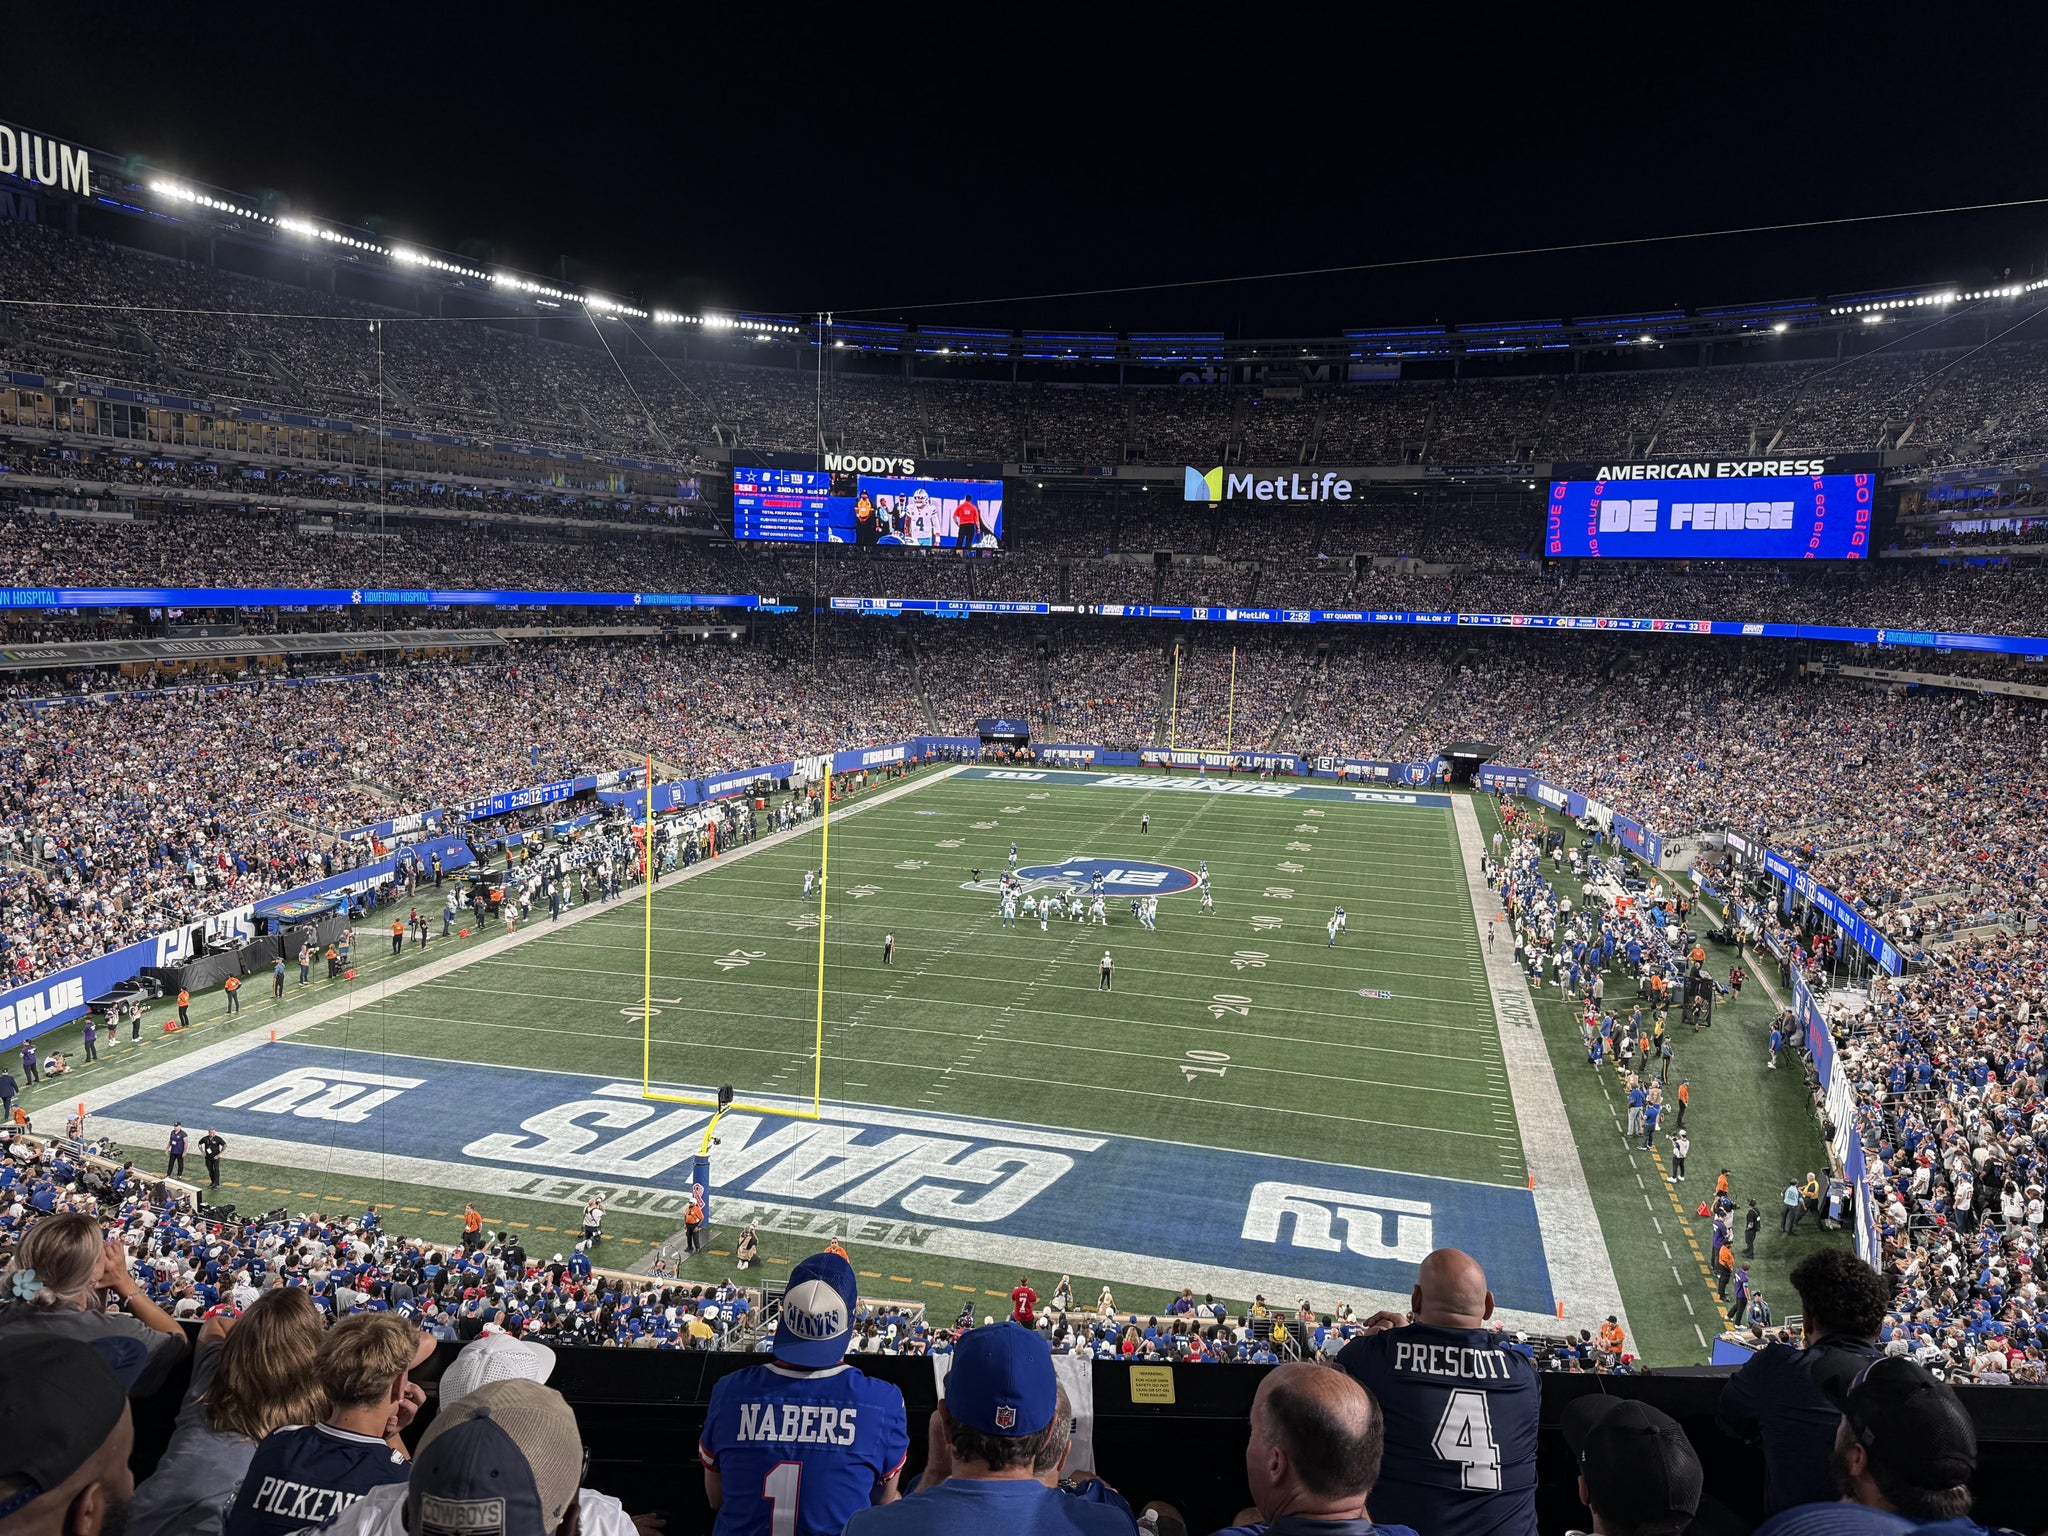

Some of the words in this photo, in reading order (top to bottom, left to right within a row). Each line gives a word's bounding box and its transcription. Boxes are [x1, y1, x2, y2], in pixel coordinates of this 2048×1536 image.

[0, 124, 90, 197] DIUM
[824, 454, 915, 475] MOODY'S
[1596, 462, 1710, 480] AMERICAN
[1716, 459, 1825, 478] EXPRESS
[807, 475, 815, 484] 7
[1227, 472, 1353, 500] MetLife
[1815, 494, 1826, 517] GO
[915, 517, 924, 532] 4
[1587, 499, 1600, 536] BLUE
[1599, 499, 1659, 532] DE
[1670, 501, 1795, 531] FENSE
[1550, 505, 1562, 553] BLUE
[1809, 521, 1824, 550] BIG
[1851, 509, 1868, 545] BIG
[13, 591, 57, 605] HOSPITAL
[364, 592, 399, 603] HOMETOWN
[400, 592, 430, 603] HOSPITAL
[1078, 605, 1085, 614] 0
[1128, 606, 1135, 615] 7
[1195, 609, 1206, 619] 12
[1239, 611, 1270, 620] MetLife
[1289, 612, 1309, 621] 2:52
[1394, 614, 1402, 622] 10
[1470, 616, 1479, 624] 10
[1523, 617, 1532, 625] 27
[1548, 618, 1553, 626] 7
[1608, 620, 1617, 628] 59
[1631, 621, 1640, 629] 37
[1742, 624, 1765, 634] GIANTS
[15, 649, 67, 661] MetLife
[158, 643, 212, 654] METLIFE
[213, 639, 264, 651] STADIUM
[792, 753, 835, 781] GIANTS
[1145, 752, 1171, 763] NEW
[1171, 752, 1198, 764] YORK
[596, 770, 620, 787] GIANTS
[530, 790, 541, 803] 12
[562, 788, 569, 797] 37
[709, 782, 721, 794] NEW
[494, 799, 503, 809] 1Q
[511, 793, 529, 807] 2:52
[392, 812, 423, 834] GIANTS
[1808, 881, 1815, 899] 12
[787, 913, 832, 928] 30
[1253, 915, 1284, 930] 40
[713, 949, 767, 967] 20
[1231, 950, 1270, 968] 30
[15, 976, 85, 1031] BLUE
[619, 997, 684, 1018] 10
[1209, 994, 1253, 1016] 20
[1497, 988, 1534, 1030] KICKOFF
[1179, 1050, 1231, 1078] 10
[461, 1083, 1109, 1223] GIANTS
[742, 1206, 936, 1247] NEVER
[1019, 1298, 1027, 1313] 7
[787, 1306, 839, 1337] GIANTS
[1394, 1341, 1511, 1380] PRESCOTT
[736, 1403, 857, 1446] NABERS
[1430, 1387, 1502, 1491] 4
[761, 1460, 803, 1536] 1
[422, 1500, 500, 1527] COWBOYS
